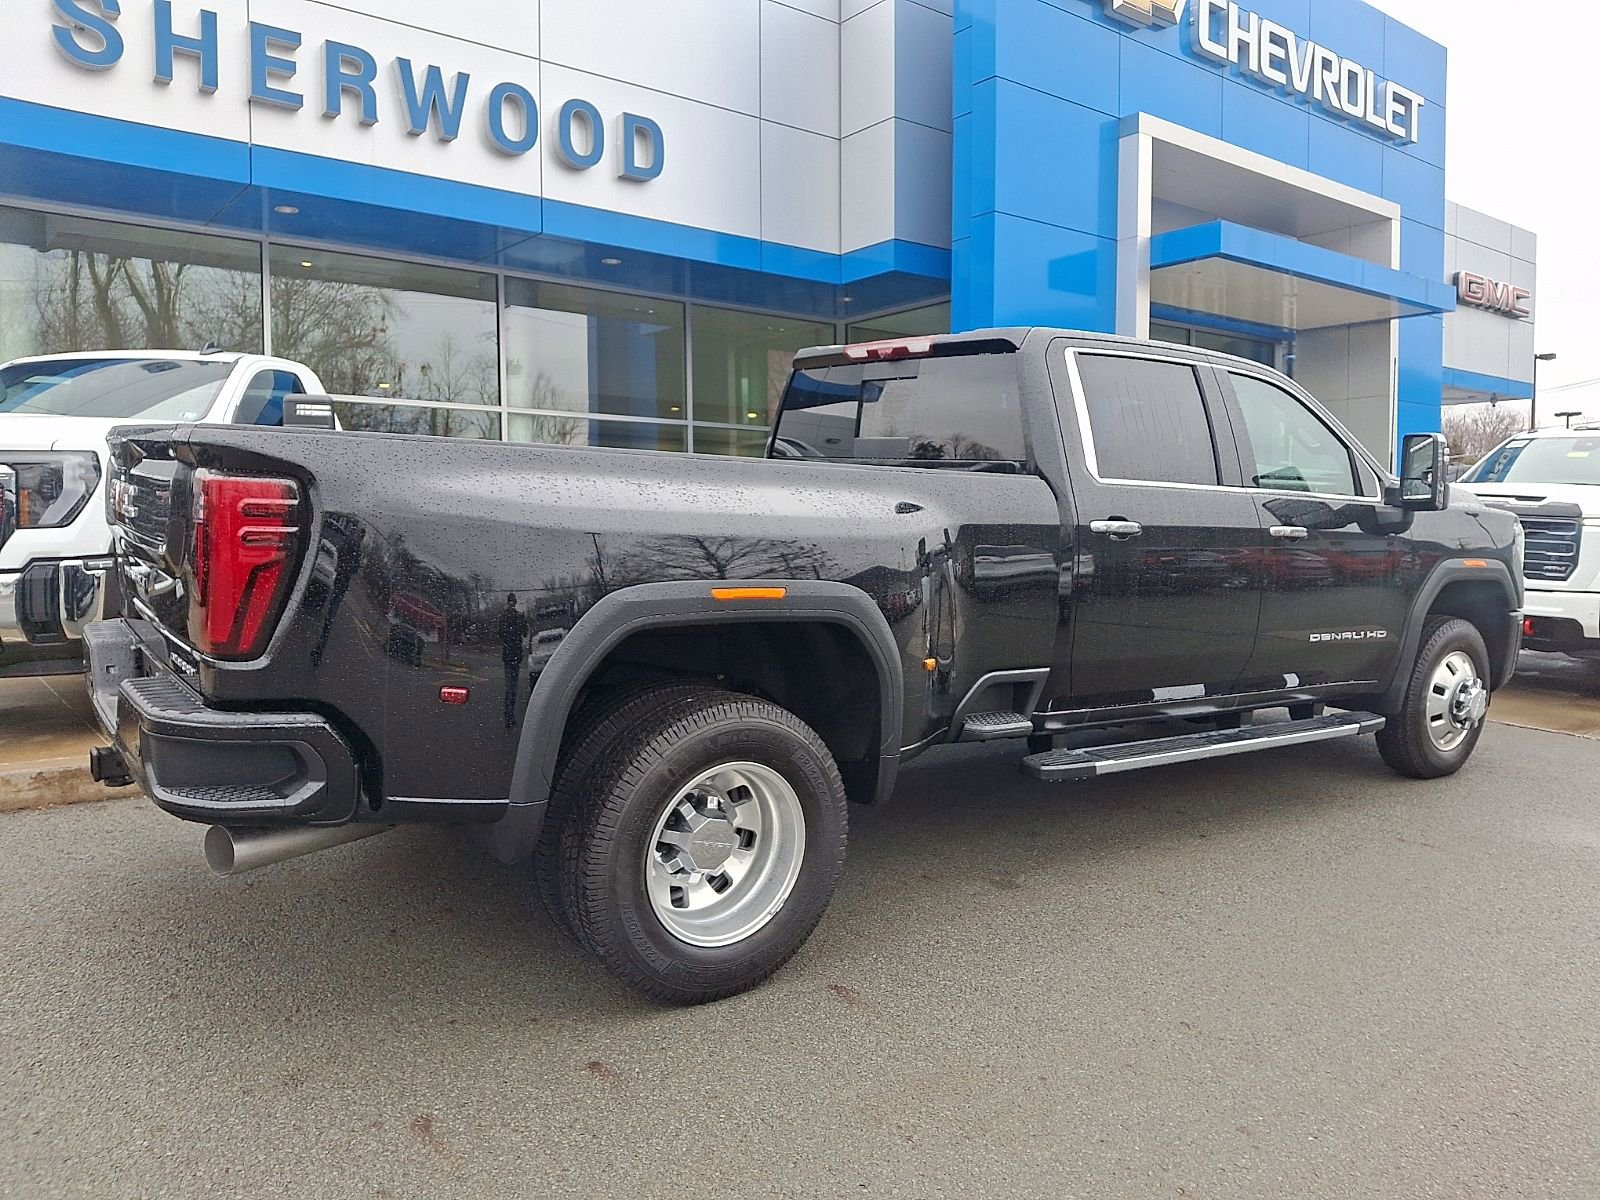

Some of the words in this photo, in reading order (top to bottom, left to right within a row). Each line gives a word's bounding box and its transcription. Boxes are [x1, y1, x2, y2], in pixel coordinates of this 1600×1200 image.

[51, 0, 664, 182] SHERWOOD
[1194, 0, 1424, 144] CHEVROLET
[1459, 271, 1530, 317] GMC
[1309, 631, 1365, 642] DENALI
[1366, 630, 1387, 639] HD
